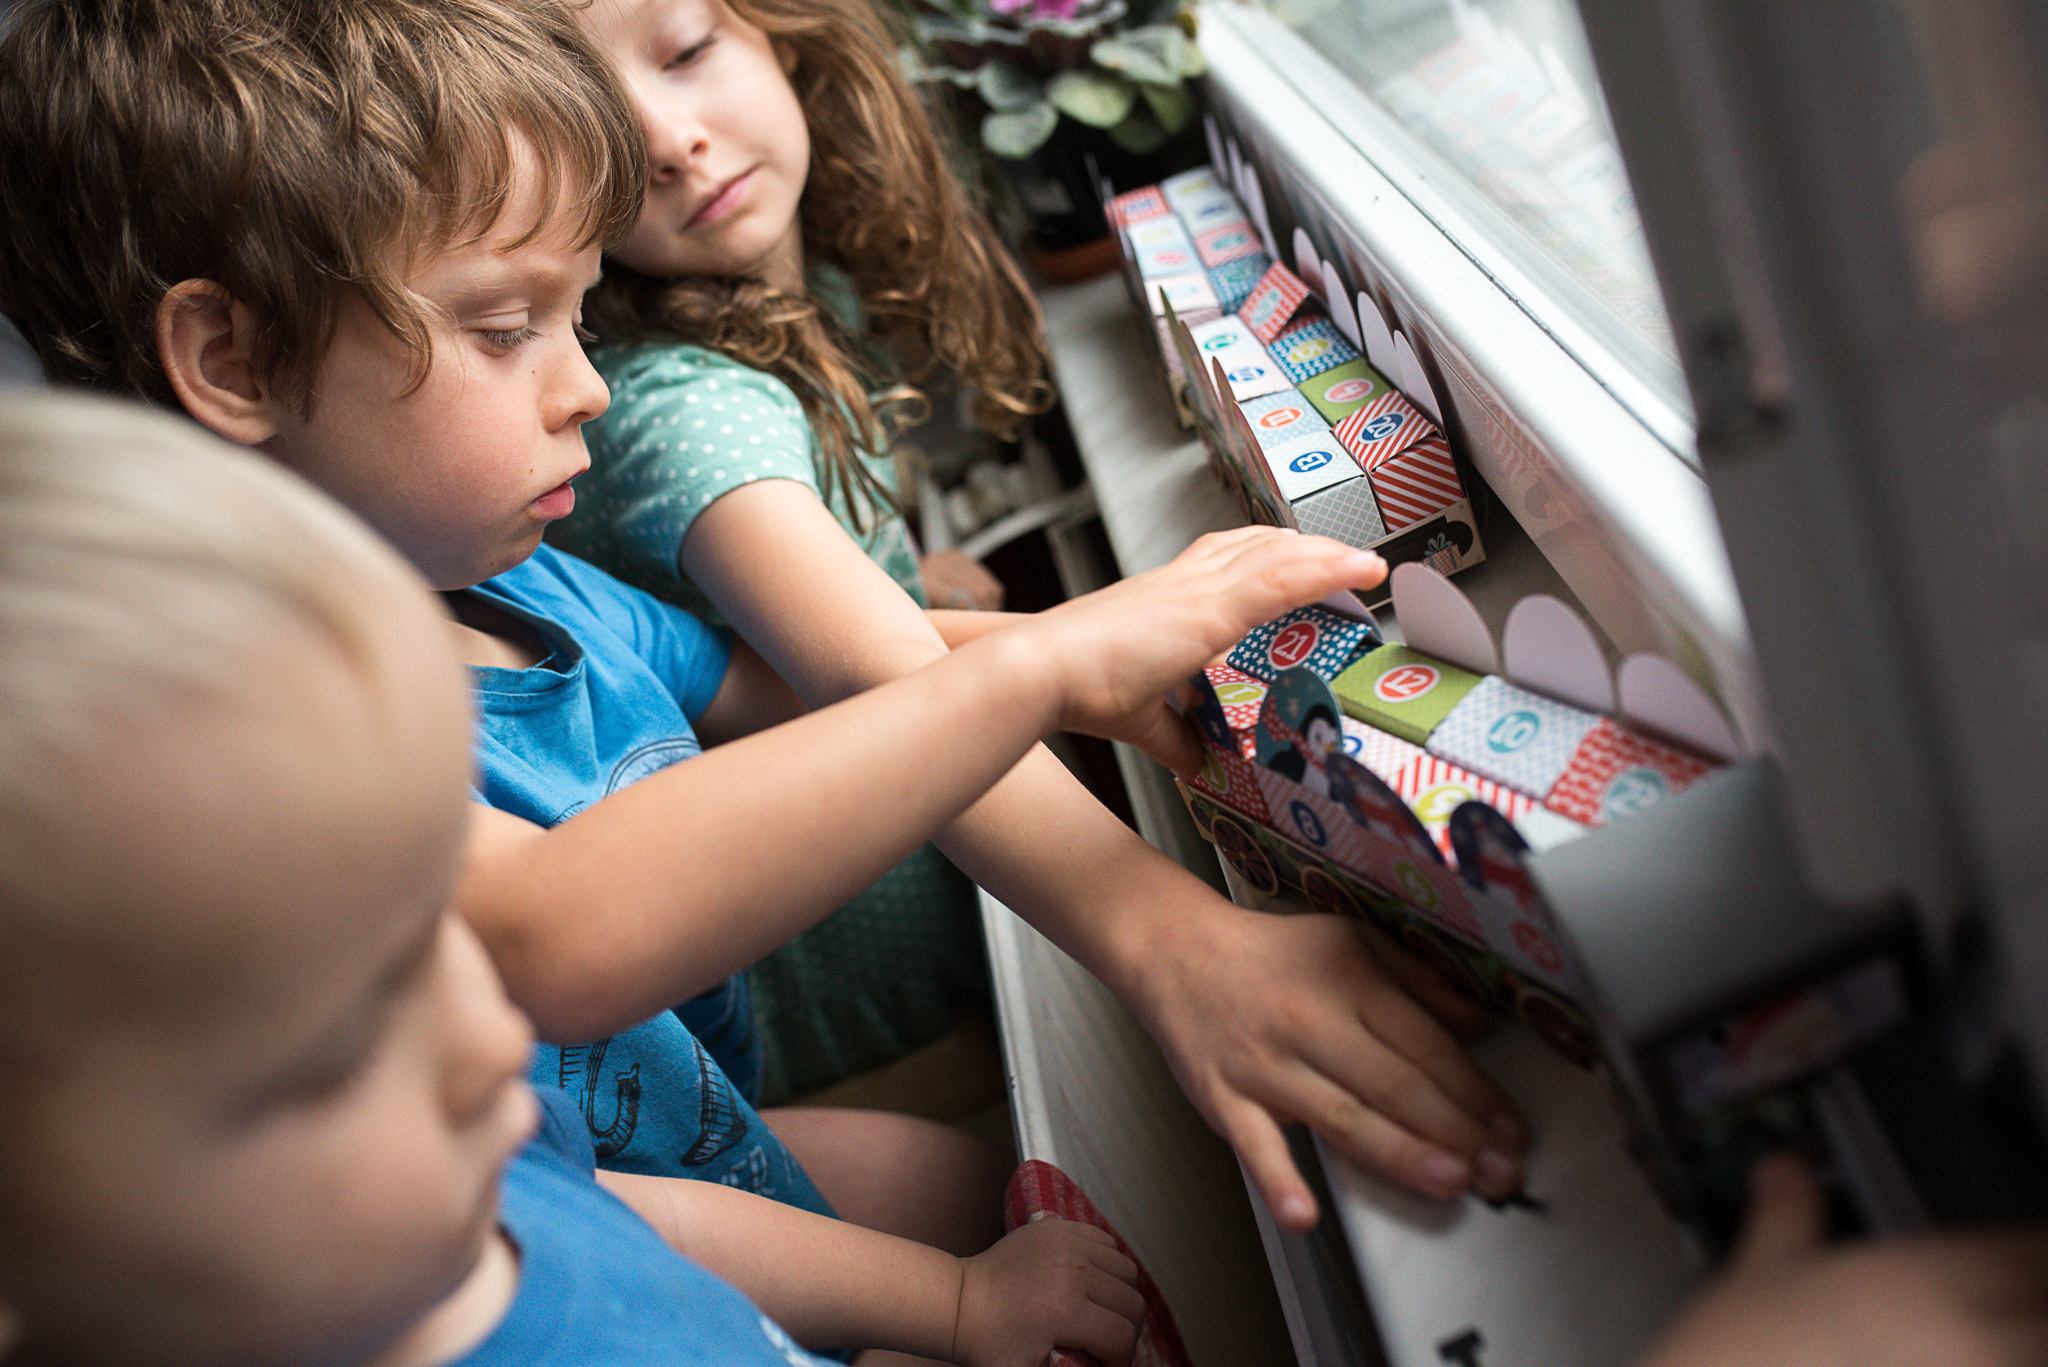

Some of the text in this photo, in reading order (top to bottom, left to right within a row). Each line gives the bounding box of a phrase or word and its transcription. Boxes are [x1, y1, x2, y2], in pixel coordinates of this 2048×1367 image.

[1265, 408, 1294, 426] 11
[1366, 416, 1396, 439] 20
[1297, 451, 1327, 471] 13
[1272, 629, 1309, 661] 21
[1383, 669, 1428, 696] 12
[1490, 714, 1537, 749] 10
